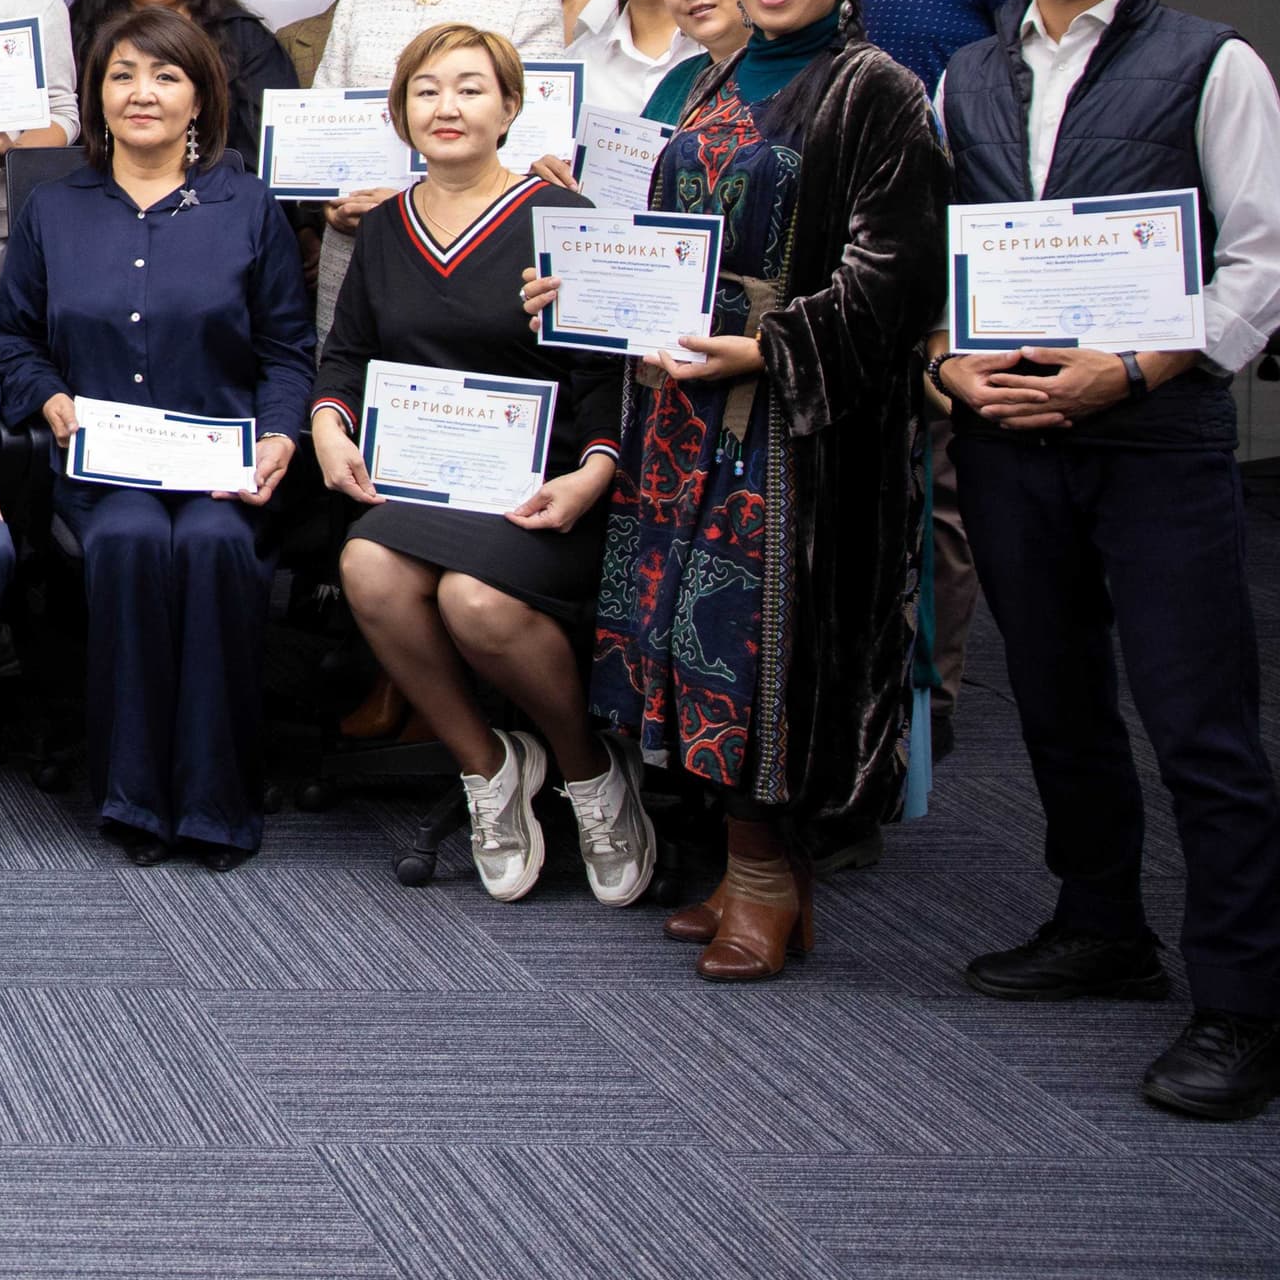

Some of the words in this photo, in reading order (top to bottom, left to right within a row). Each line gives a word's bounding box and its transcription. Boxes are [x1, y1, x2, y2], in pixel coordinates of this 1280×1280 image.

[284, 113, 372, 125] СЕРТИФИКАТ
[562, 240, 666, 258] СЕРТИФИКАТ
[983, 232, 1121, 252] СЕРТИФИКАТ
[391, 398, 496, 419] СЕРТИФИКАТ
[97, 421, 197, 440] СЕРТИФИКАТ
